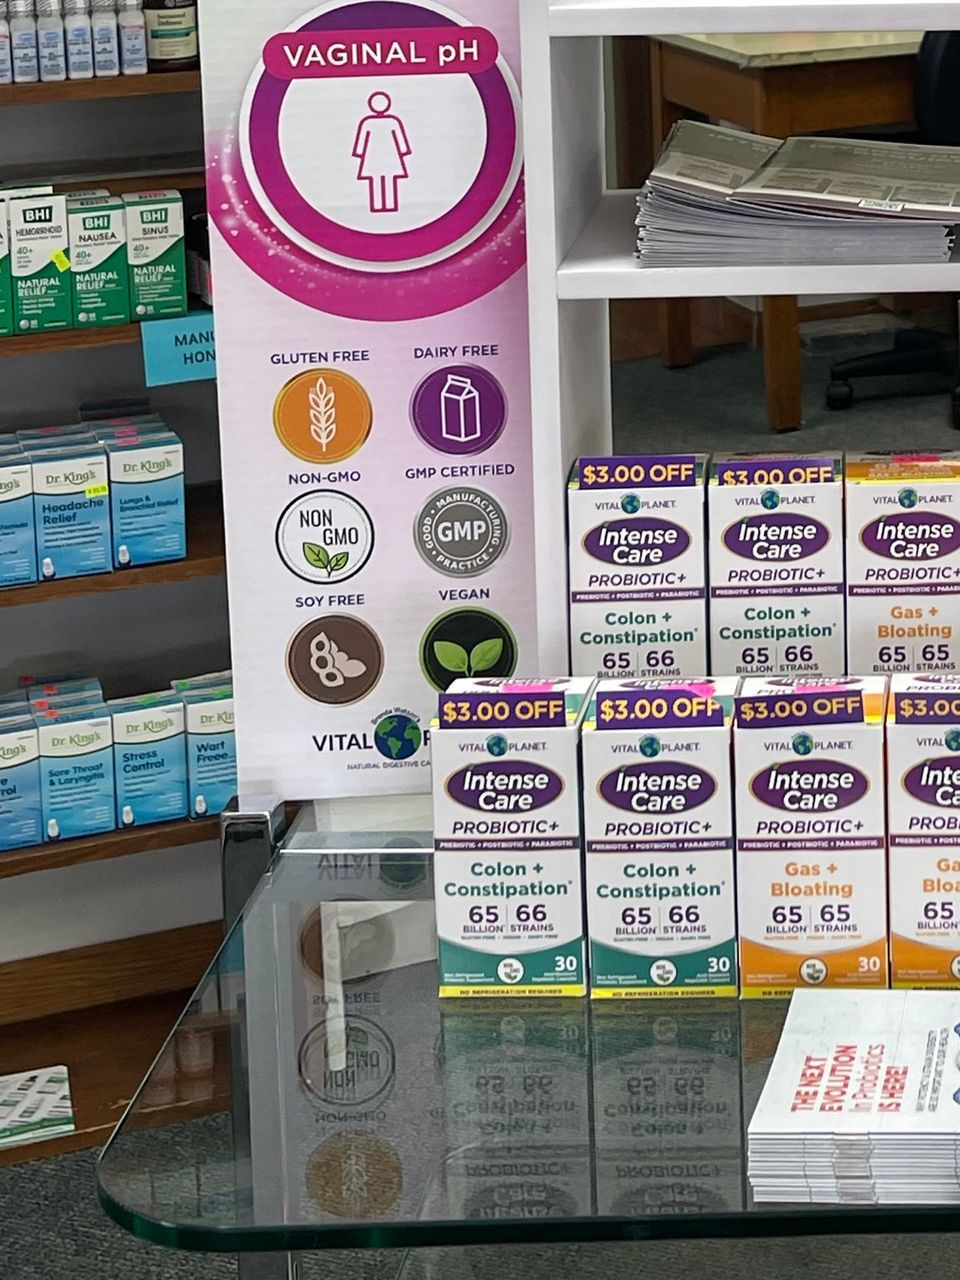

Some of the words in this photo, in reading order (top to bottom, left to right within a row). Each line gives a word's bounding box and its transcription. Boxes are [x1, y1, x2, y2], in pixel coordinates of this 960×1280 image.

[283, 41, 427, 68] VAGINAL
[438, 39, 479, 67] pH
[25, 208, 50, 222] BHI
[143, 210, 166, 222] BHI
[85, 217, 108, 229] BHI
[15, 226, 62, 237] HEMORRHOID
[79, 232, 117, 243] NAUSEA
[142, 226, 169, 236] SINUS
[133, 244, 150, 253] 40+
[133, 264, 176, 276] NATURAL
[17, 277, 61, 289] NATURAL
[134, 274, 163, 284] RELIEF
[18, 287, 47, 297] RELIEF
[270, 351, 329, 365] GLUTEN
[332, 350, 370, 363] FREE
[414, 346, 458, 359] DAIRY
[462, 344, 499, 357] FREE
[141, 458, 173, 473] King's
[405, 468, 437, 480] GMP
[441, 464, 515, 477] CERTIFIED
[64, 470, 96, 485] King's
[288, 471, 361, 485] NON-GMO
[42, 499, 104, 514] Headache
[43, 512, 77, 525] Relief
[299, 509, 333, 527] NON
[435, 493, 502, 547] MANUFACTURING
[322, 527, 359, 546] GMO
[422, 516, 433, 550] GOOD
[437, 520, 487, 543] GMP
[436, 548, 490, 570] PRACTICE
[295, 595, 324, 608] SOY
[328, 594, 365, 607] FREE
[439, 588, 490, 601] VEGAN
[877, 624, 952, 639] Bloating
[442, 701, 510, 722] $3.00
[515, 699, 563, 720] OFF
[143, 718, 175, 733] King's
[69, 731, 102, 747] King's
[312, 732, 374, 753] VITAL
[196, 741, 225, 753] Wart
[459, 742, 487, 752] VITAL
[509, 742, 546, 752] PLANET
[122, 750, 158, 762] Stress
[122, 758, 165, 773] Control
[463, 767, 549, 791] Intense
[478, 792, 533, 811] Care
[470, 862, 526, 876] Colon
[785, 862, 820, 876] Gas
[770, 881, 853, 899] Bloating
[469, 905, 499, 924] 65
[516, 904, 547, 923] 66
[463, 924, 503, 933] BILLION
[510, 923, 554, 932] STRAINS
[555, 956, 577, 971] 30
[798, 1055, 828, 1088] NEXT
[819, 1044, 858, 1113] EVOLUTION
[851, 1044, 886, 1100] Probiotics
[790, 1090, 819, 1113] THE
[877, 1102, 901, 1113] IS
